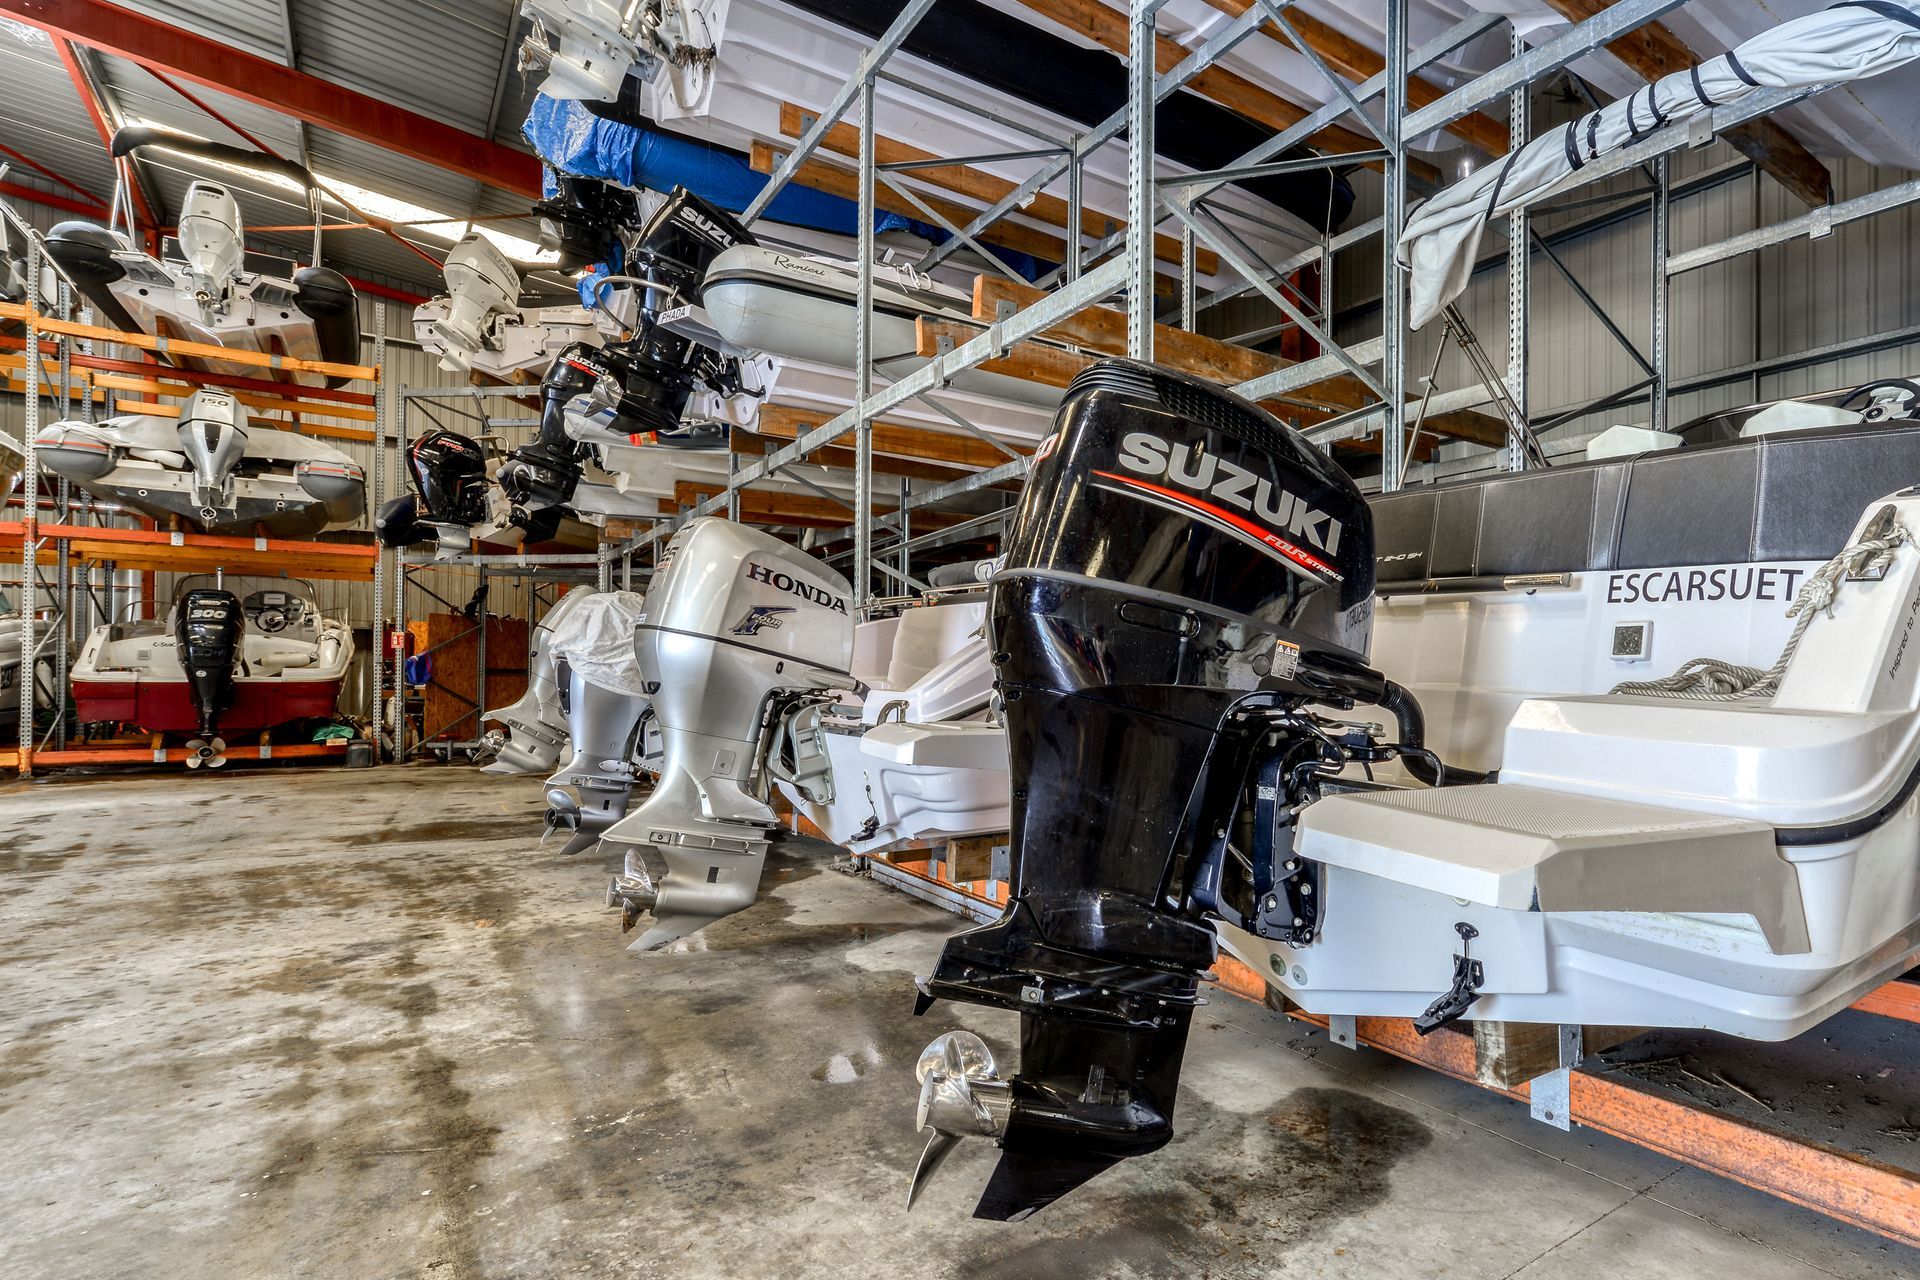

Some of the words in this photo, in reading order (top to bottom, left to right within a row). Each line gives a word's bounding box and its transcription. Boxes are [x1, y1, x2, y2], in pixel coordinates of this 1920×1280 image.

[763, 251, 825, 276] Ranieri
[566, 353, 609, 375] SUZUKI
[200, 397, 229, 407] 150
[1118, 432, 1342, 557] SUZUKI
[1264, 534, 1308, 561] FOUR
[1305, 558, 1345, 582] STROKE
[746, 561, 849, 617] HONDA
[1607, 568, 1804, 604] ESCARSUET
[190, 608, 227, 619] 300
[1888, 629, 1909, 680] Inspired
[1907, 616, 1914, 630] to
